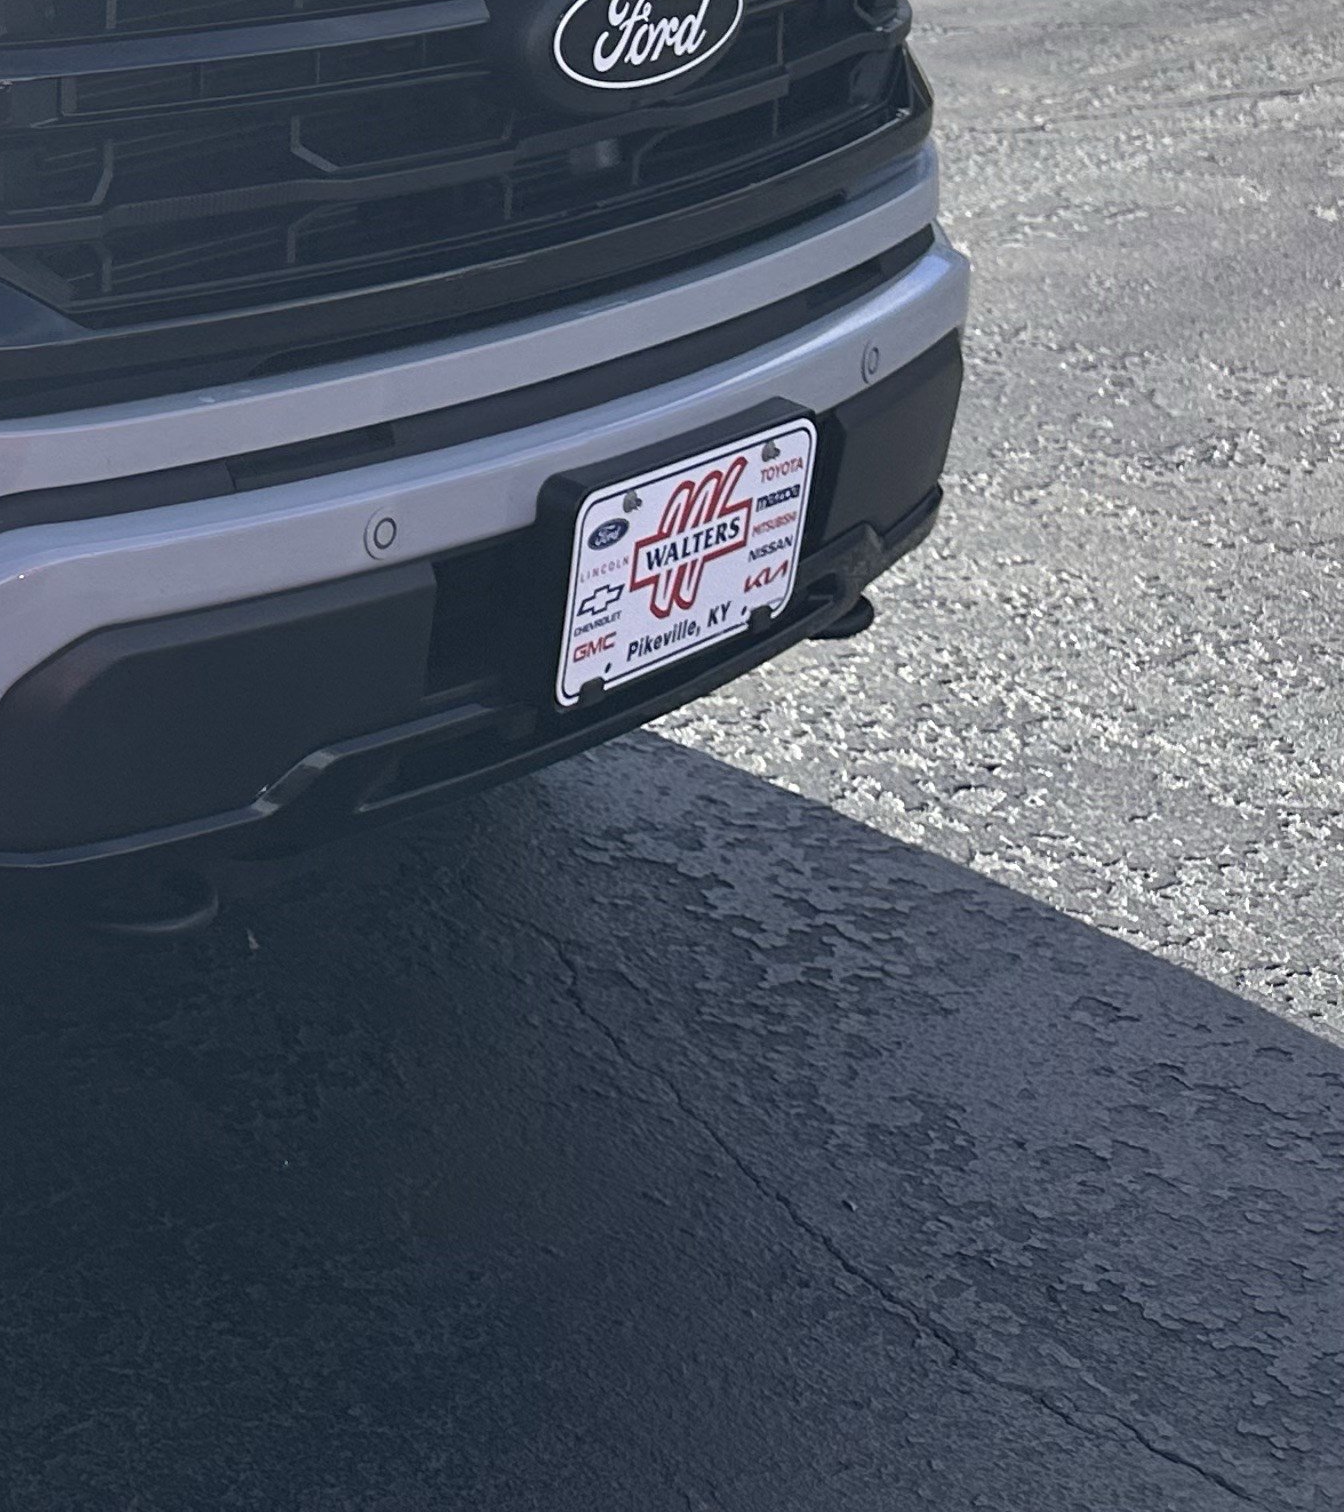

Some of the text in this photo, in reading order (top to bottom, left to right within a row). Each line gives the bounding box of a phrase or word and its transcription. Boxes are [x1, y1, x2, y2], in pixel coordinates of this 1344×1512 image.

[761, 456, 804, 483] TOYOTA
[645, 516, 741, 572] WALTERS
[748, 536, 793, 562] NISSAN
[579, 554, 629, 584] LINCOLN
[573, 610, 622, 638] CHEVROLET
[626, 600, 732, 663] Pikeville, KY
[573, 631, 617, 664] GMC
